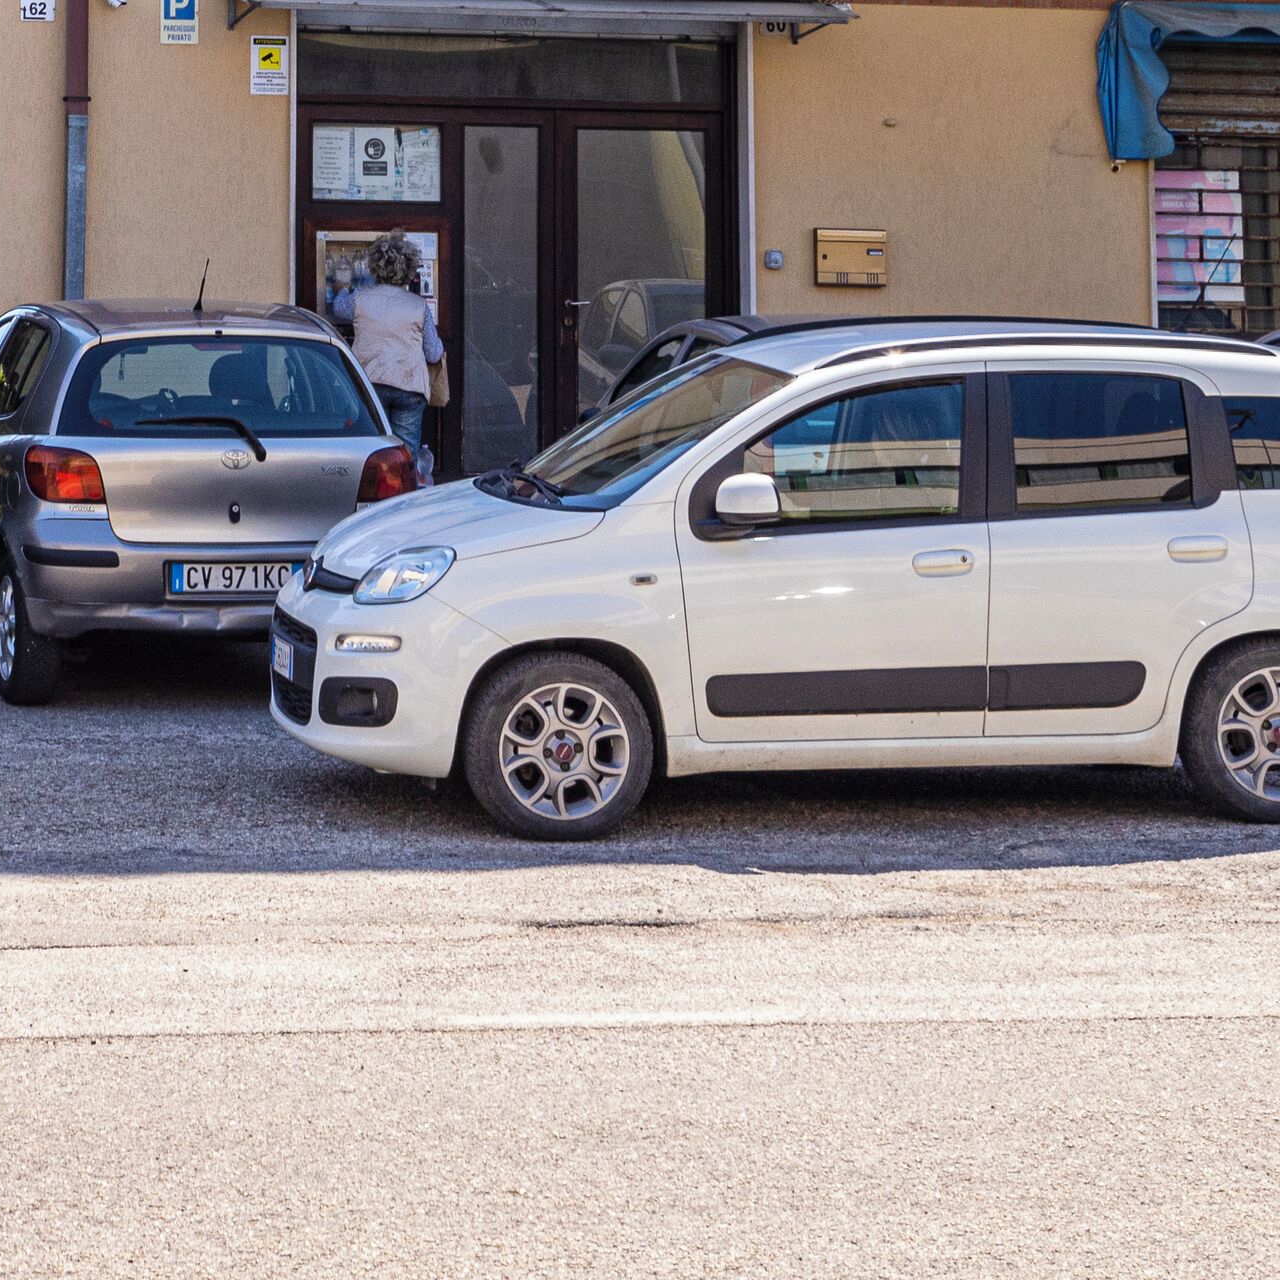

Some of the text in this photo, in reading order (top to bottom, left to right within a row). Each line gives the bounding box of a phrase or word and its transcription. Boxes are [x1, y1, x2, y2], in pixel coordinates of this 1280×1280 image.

[29, 2, 47, 16] 62
[163, 25, 196, 33] PARCHEGGIO
[187, 566, 212, 589] CV
